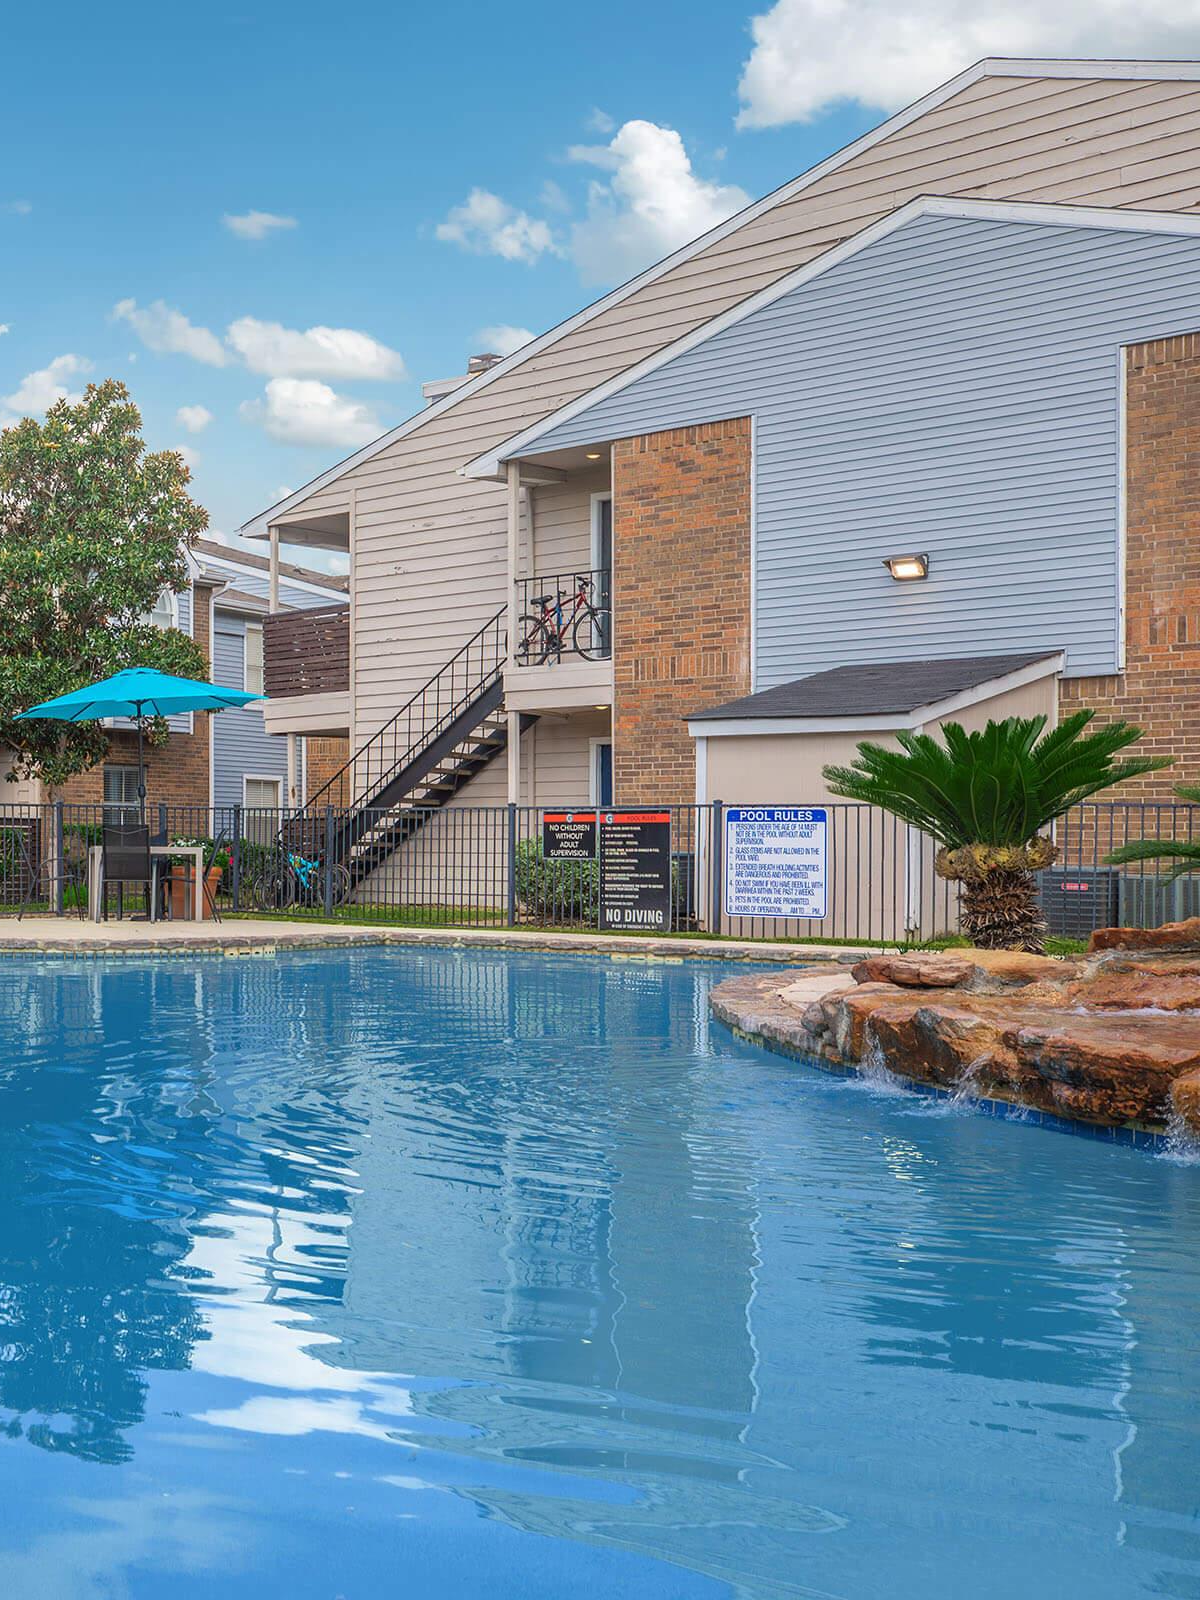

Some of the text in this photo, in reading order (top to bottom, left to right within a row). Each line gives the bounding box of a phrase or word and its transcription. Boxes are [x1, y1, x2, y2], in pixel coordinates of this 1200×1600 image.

[740, 812, 813, 820] POOL RULES
[606, 908, 664, 924] NO DIVING
